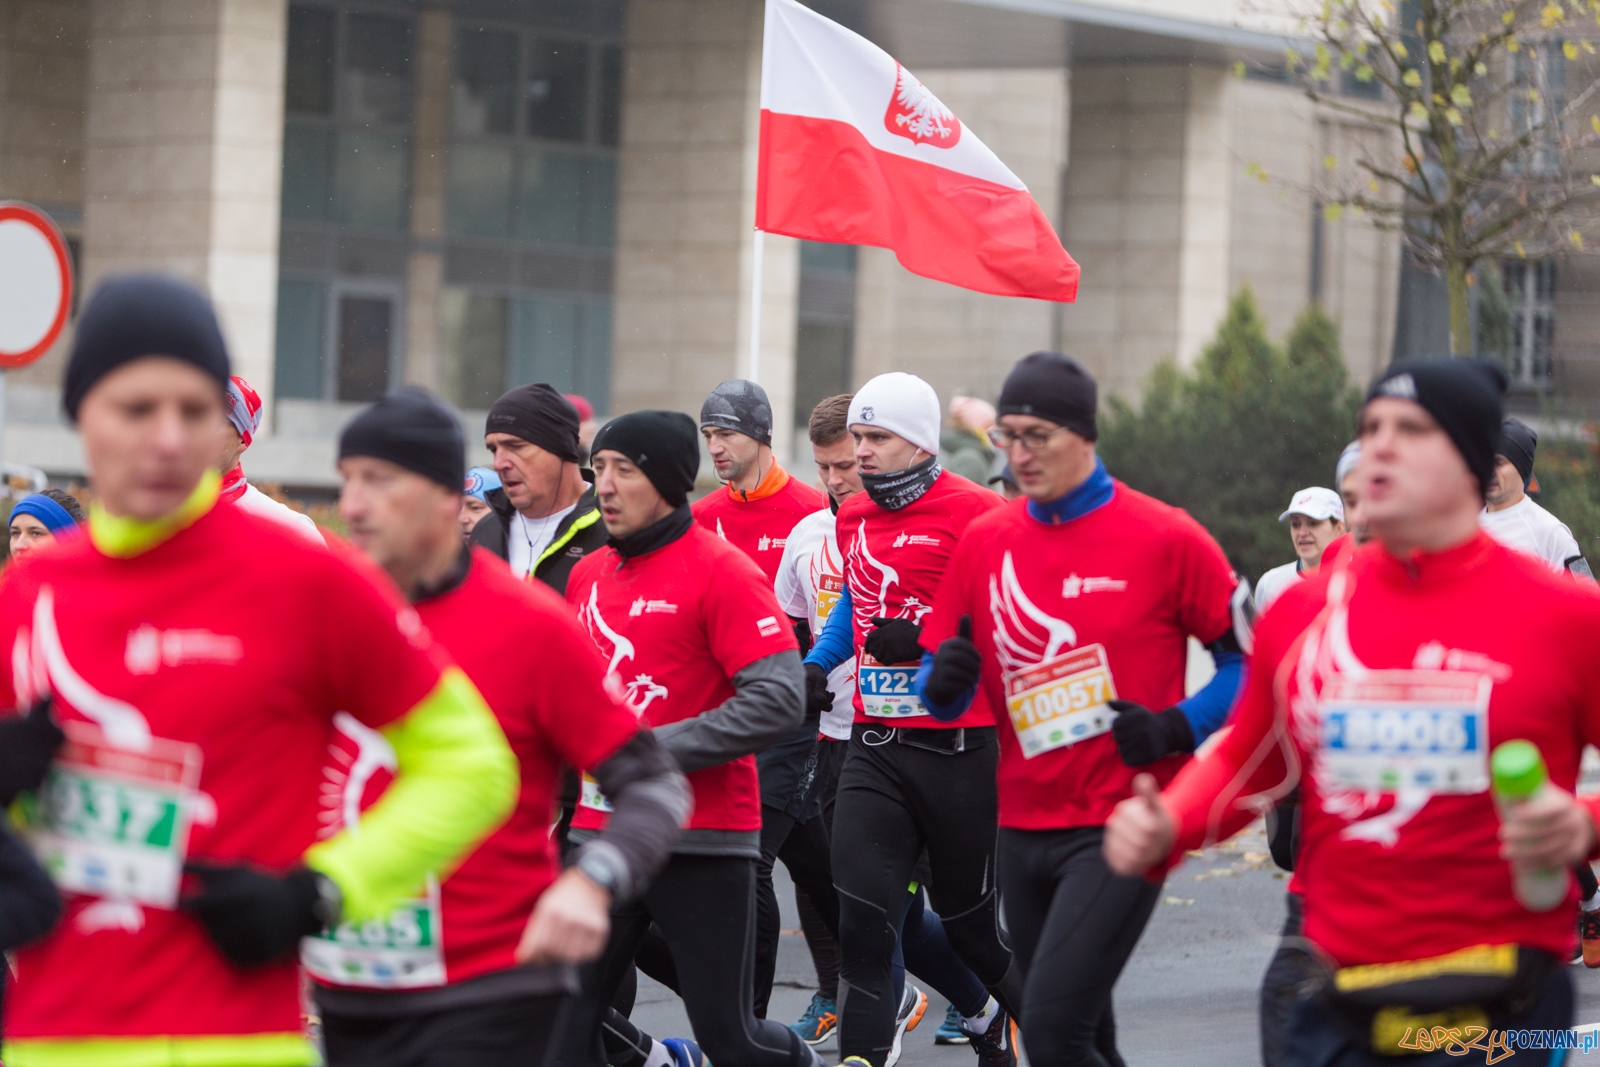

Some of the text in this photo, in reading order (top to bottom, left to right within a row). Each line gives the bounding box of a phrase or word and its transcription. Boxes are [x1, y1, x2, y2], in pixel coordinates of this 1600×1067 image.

[860, 671, 917, 693] E 122
[1020, 675, 1105, 725] 10057
[1345, 709, 1468, 750] 8006
